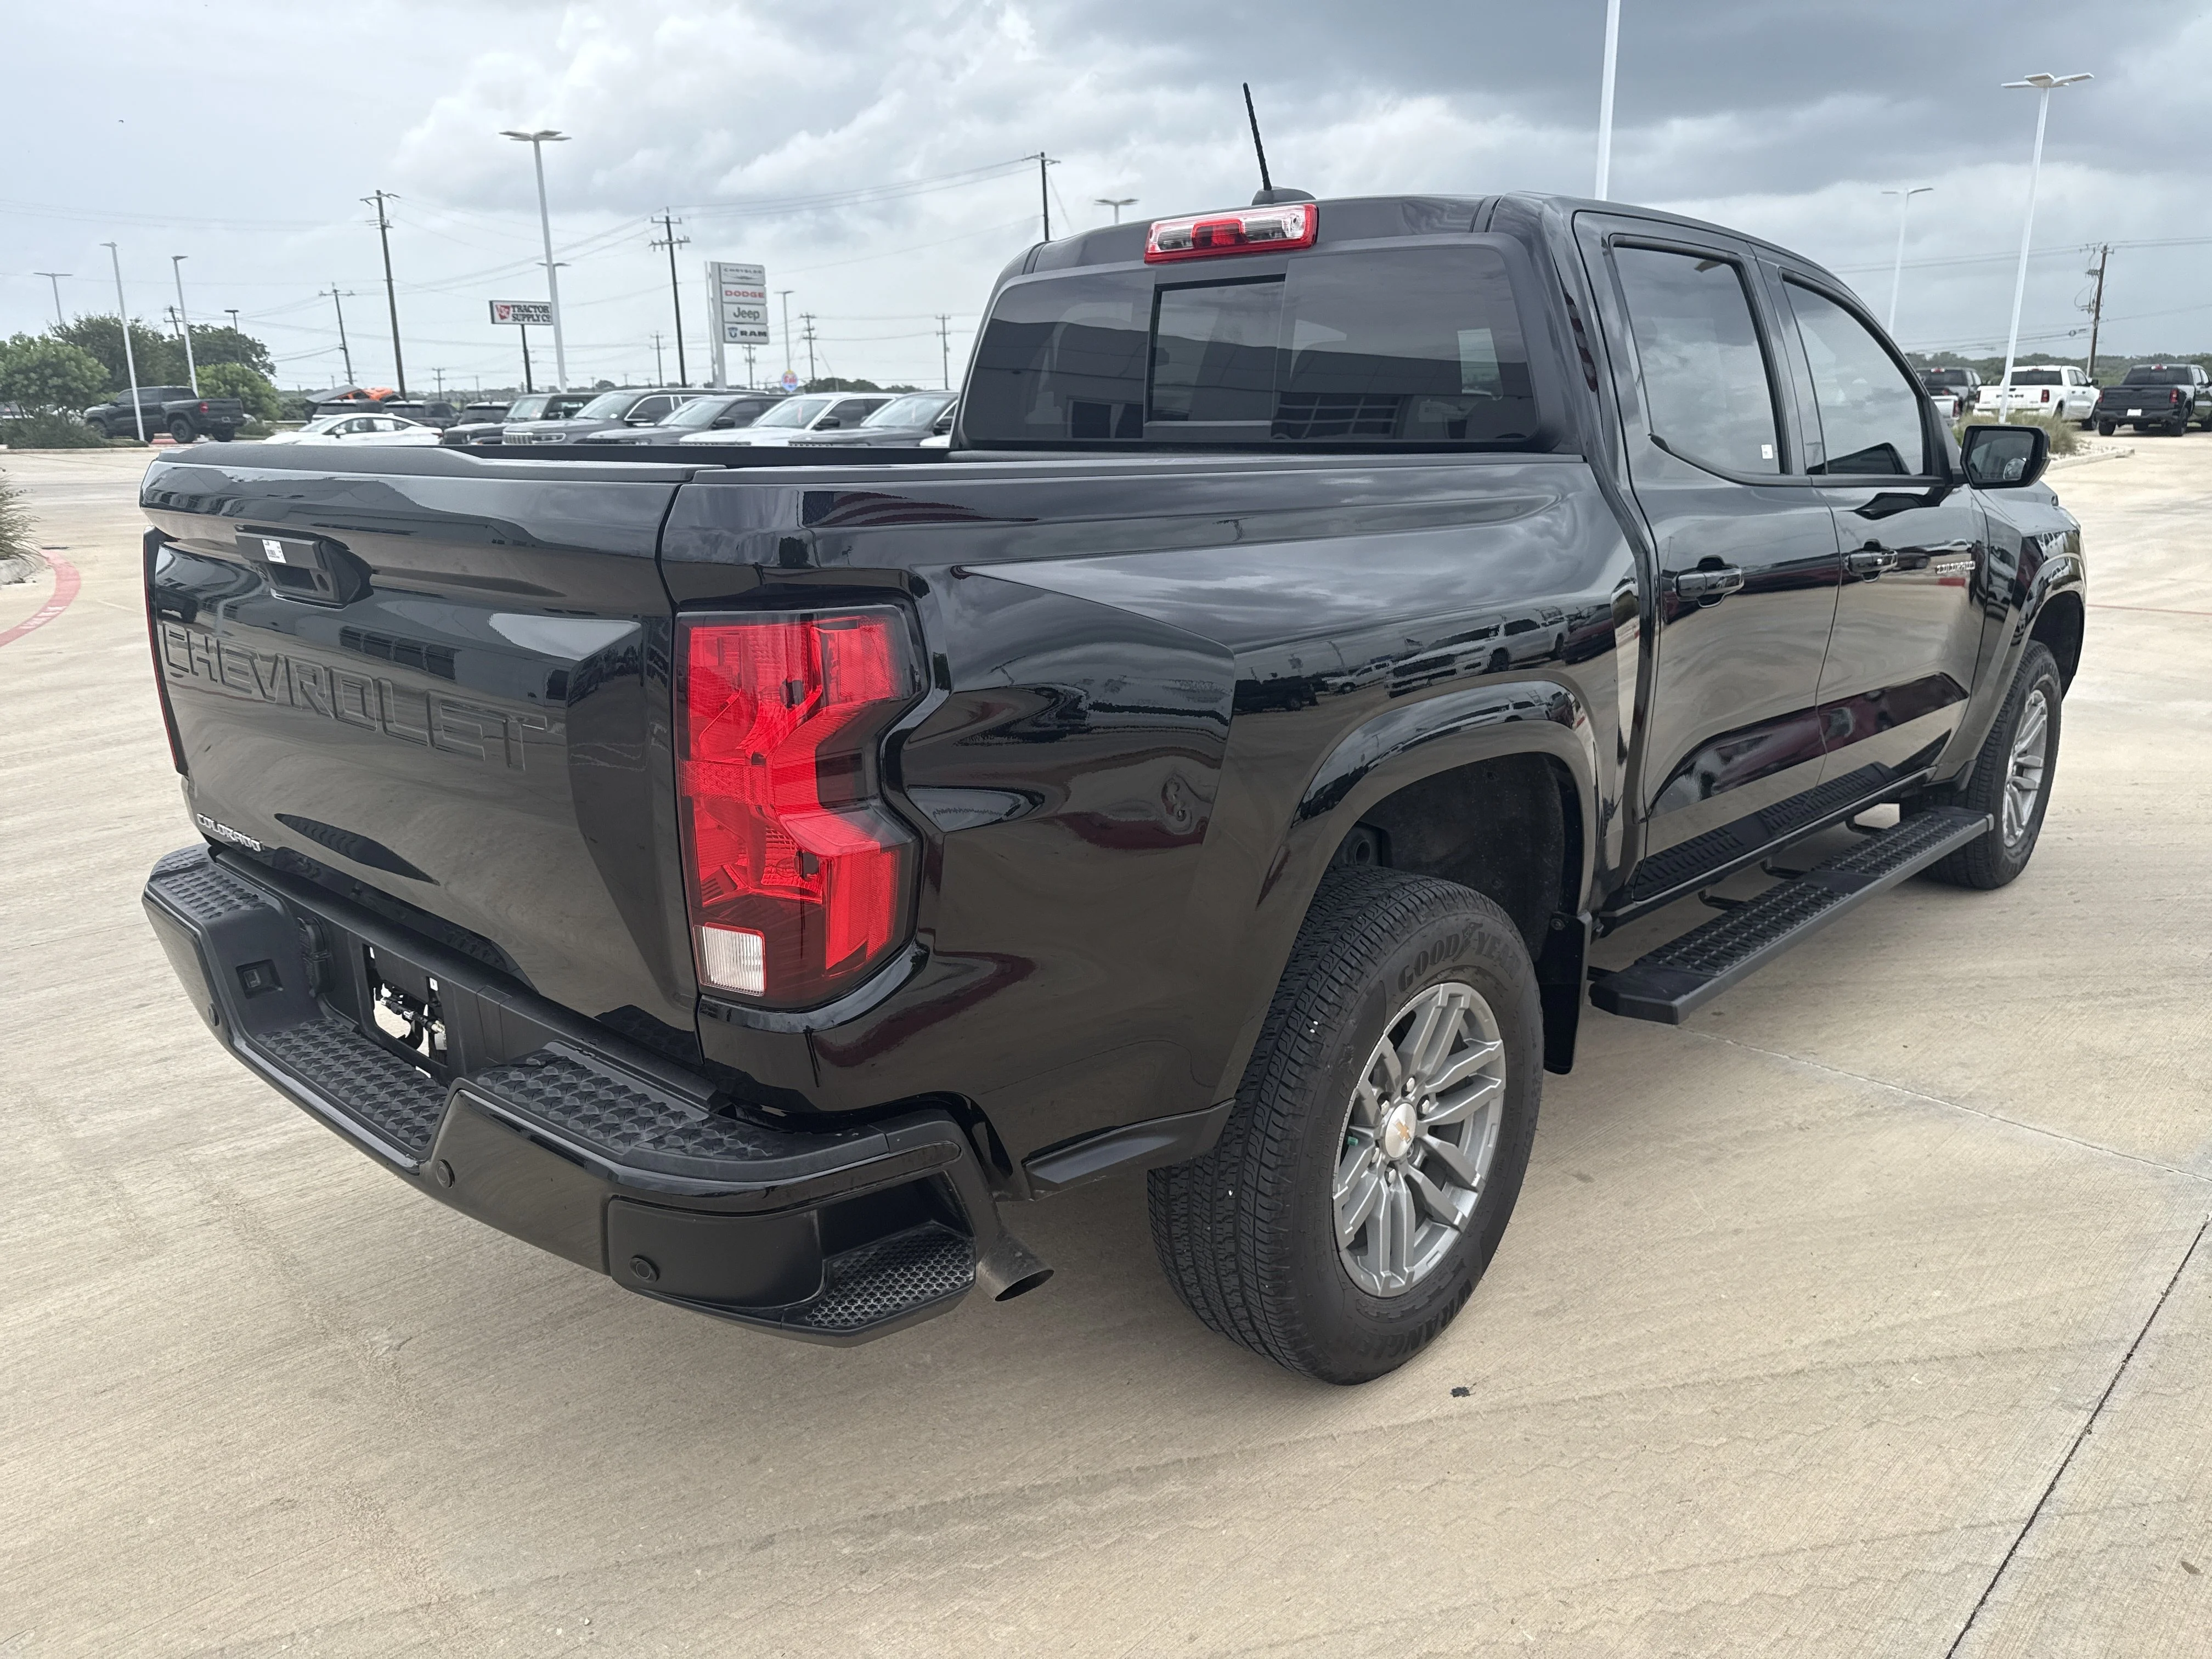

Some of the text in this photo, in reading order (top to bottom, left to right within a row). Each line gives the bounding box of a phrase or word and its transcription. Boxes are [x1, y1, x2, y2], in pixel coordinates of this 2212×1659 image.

[725, 290, 764, 298] DODGE
[511, 304, 550, 313] TRACTOR
[733, 307, 760, 321] Jeep
[511, 314, 540, 322] SUPPLY
[162, 620, 548, 771] CHEVROLET
[197, 813, 262, 852] COLORADO
